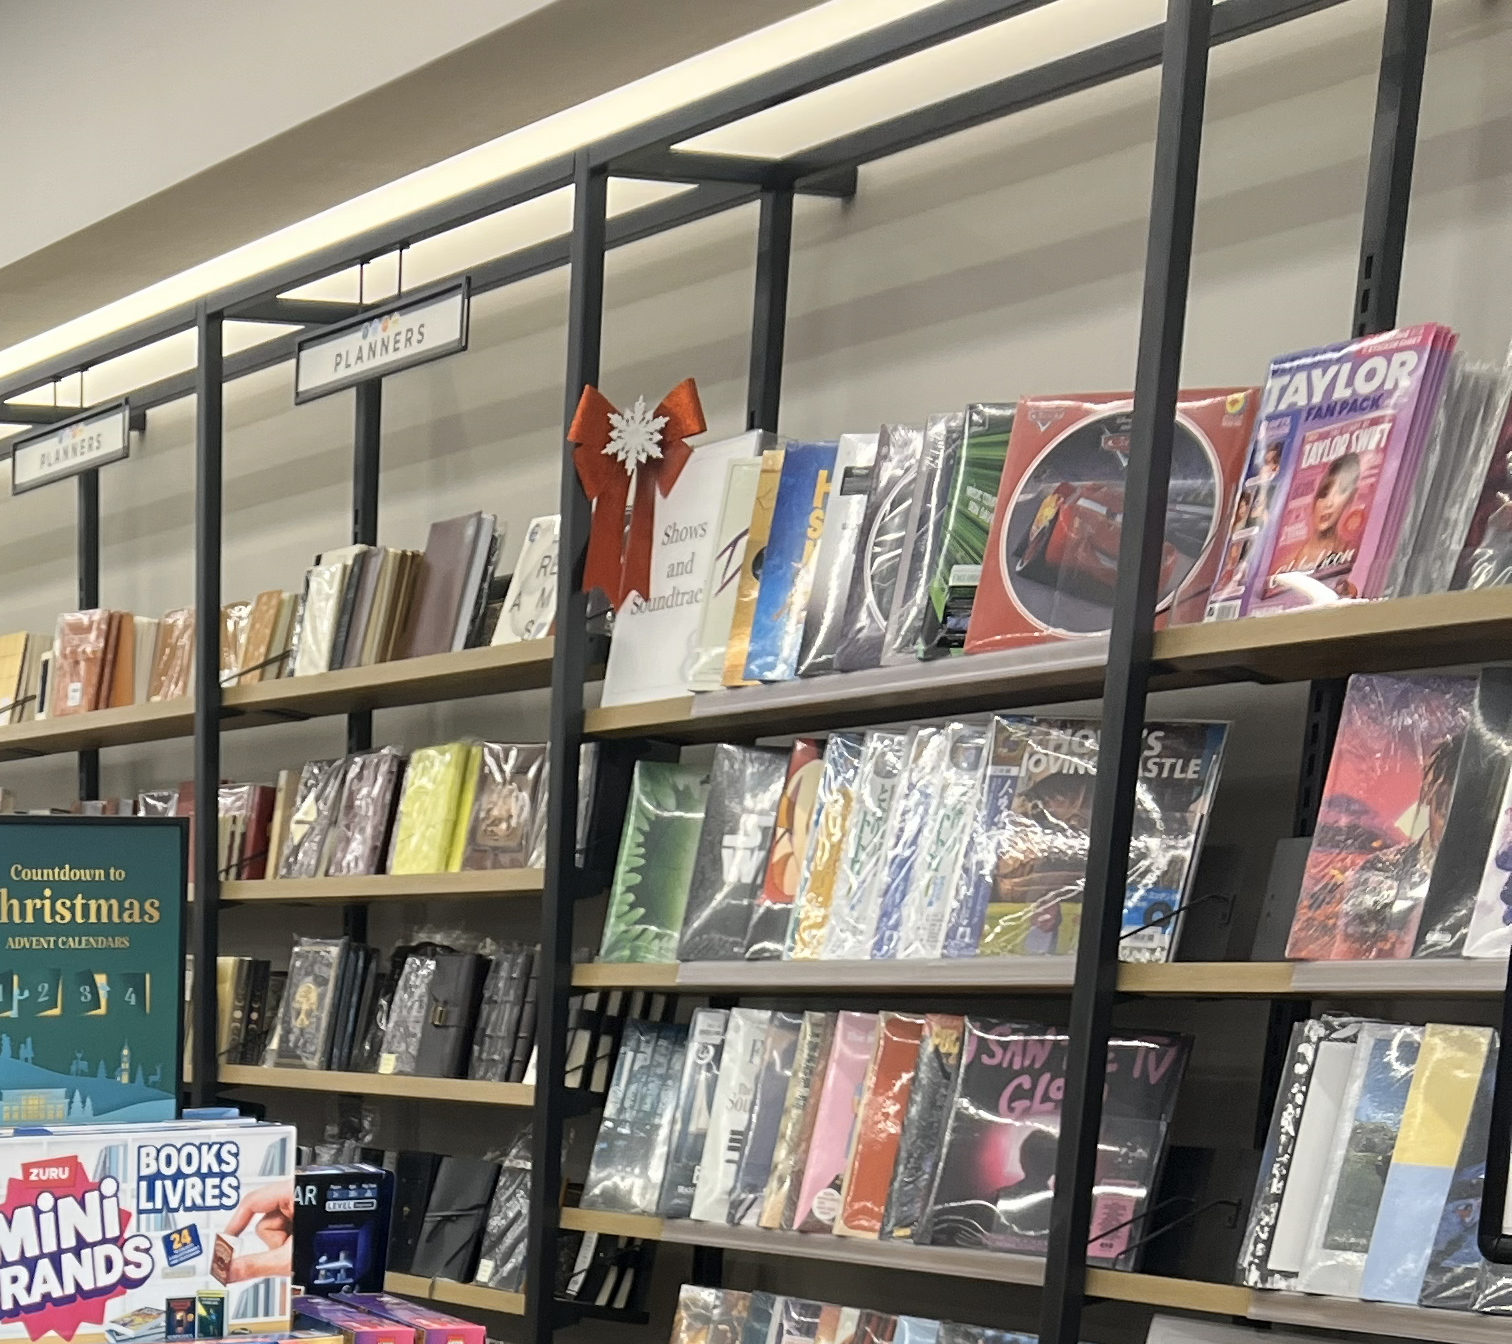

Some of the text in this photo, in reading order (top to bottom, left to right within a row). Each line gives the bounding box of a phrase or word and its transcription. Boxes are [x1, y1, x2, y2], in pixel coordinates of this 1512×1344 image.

[333, 323, 427, 374] PLANNERS
[1266, 350, 1419, 412] TAYLOR
[1304, 393, 1383, 422] FAN PACK
[39, 433, 103, 470] PLANNERS
[1301, 422, 1392, 469] TAYLOR SWIFT
[661, 520, 709, 547] Shows
[666, 552, 694, 579] and
[10, 864, 126, 881] Countdown to
[5, 936, 130, 950] ADVENT CALENDARS
[37, 982, 137, 1006] 2 3 4
[981, 1026, 1057, 1070] SAW
[138, 1142, 239, 1177] BOOKS
[28, 1166, 70, 1182] ZURU
[138, 1177, 239, 1211] LIVRES
[327, 1201, 353, 1211] LEVEL
[170, 1230, 193, 1250] 24
